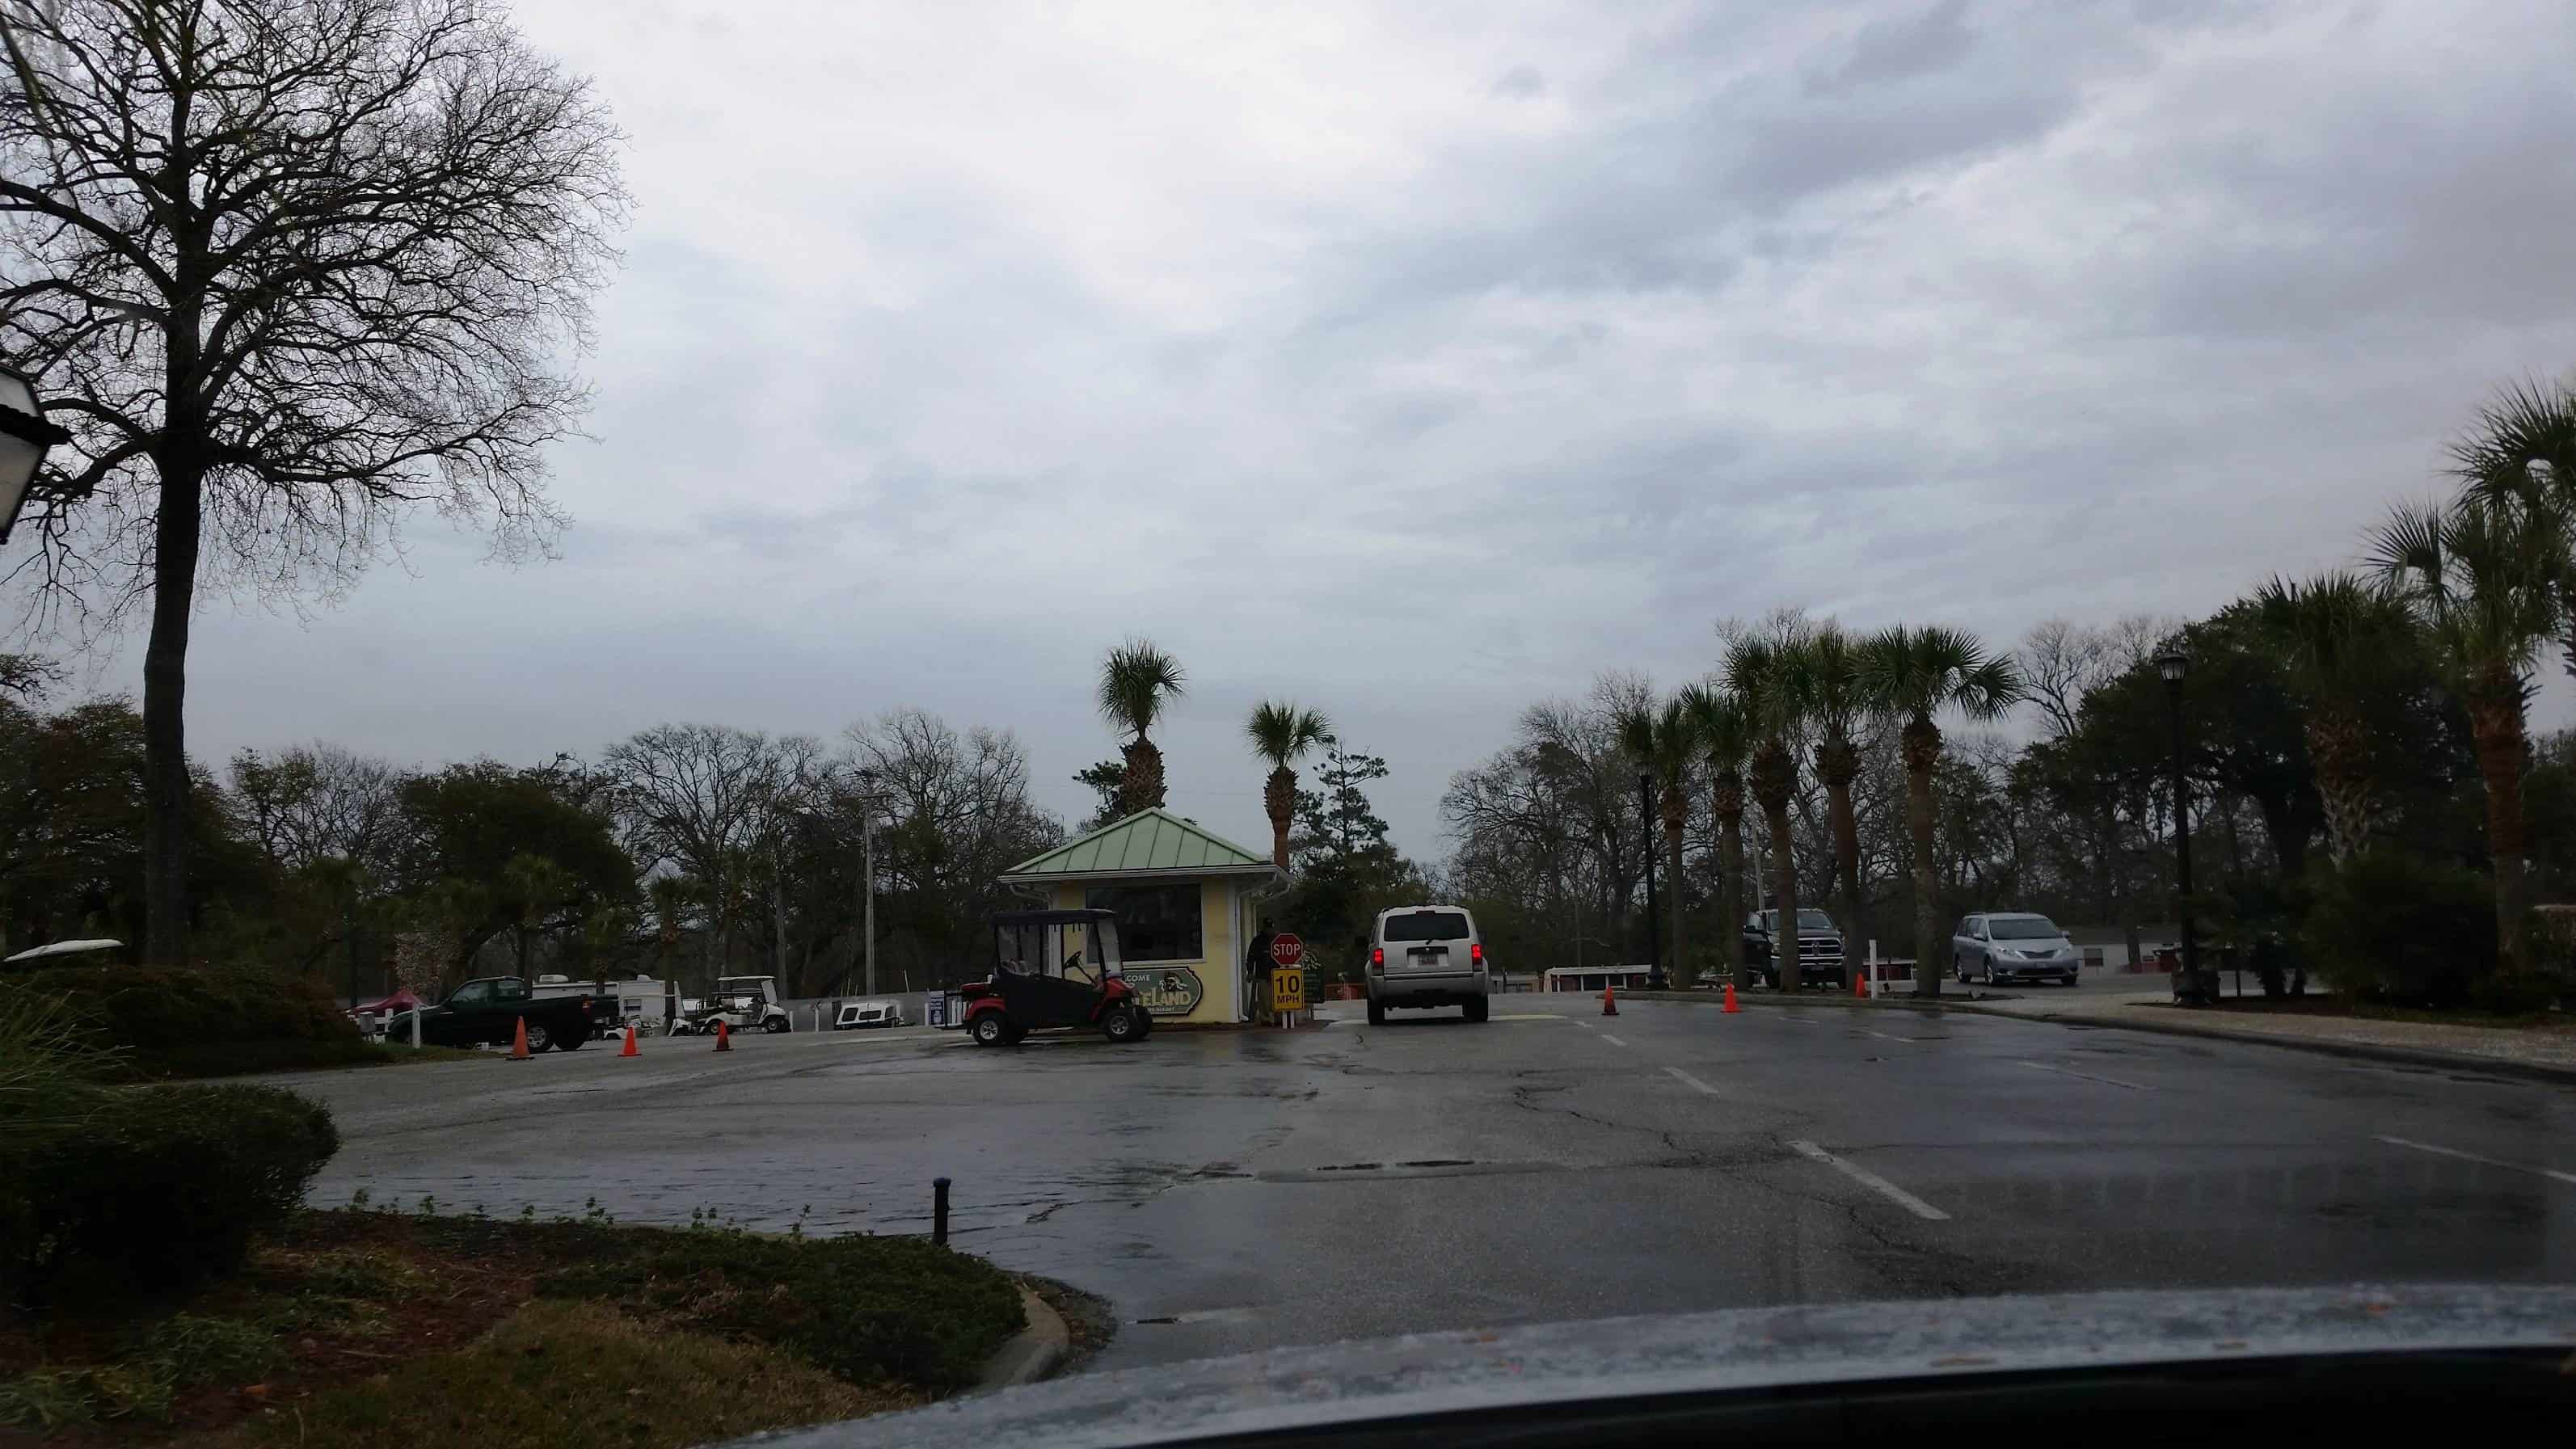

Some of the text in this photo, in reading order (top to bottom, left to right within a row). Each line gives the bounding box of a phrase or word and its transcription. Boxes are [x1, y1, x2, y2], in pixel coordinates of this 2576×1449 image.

[1273, 943, 1301, 957] STOP
[1275, 975, 1300, 993] 10
[1277, 995, 1299, 1003] MPH
